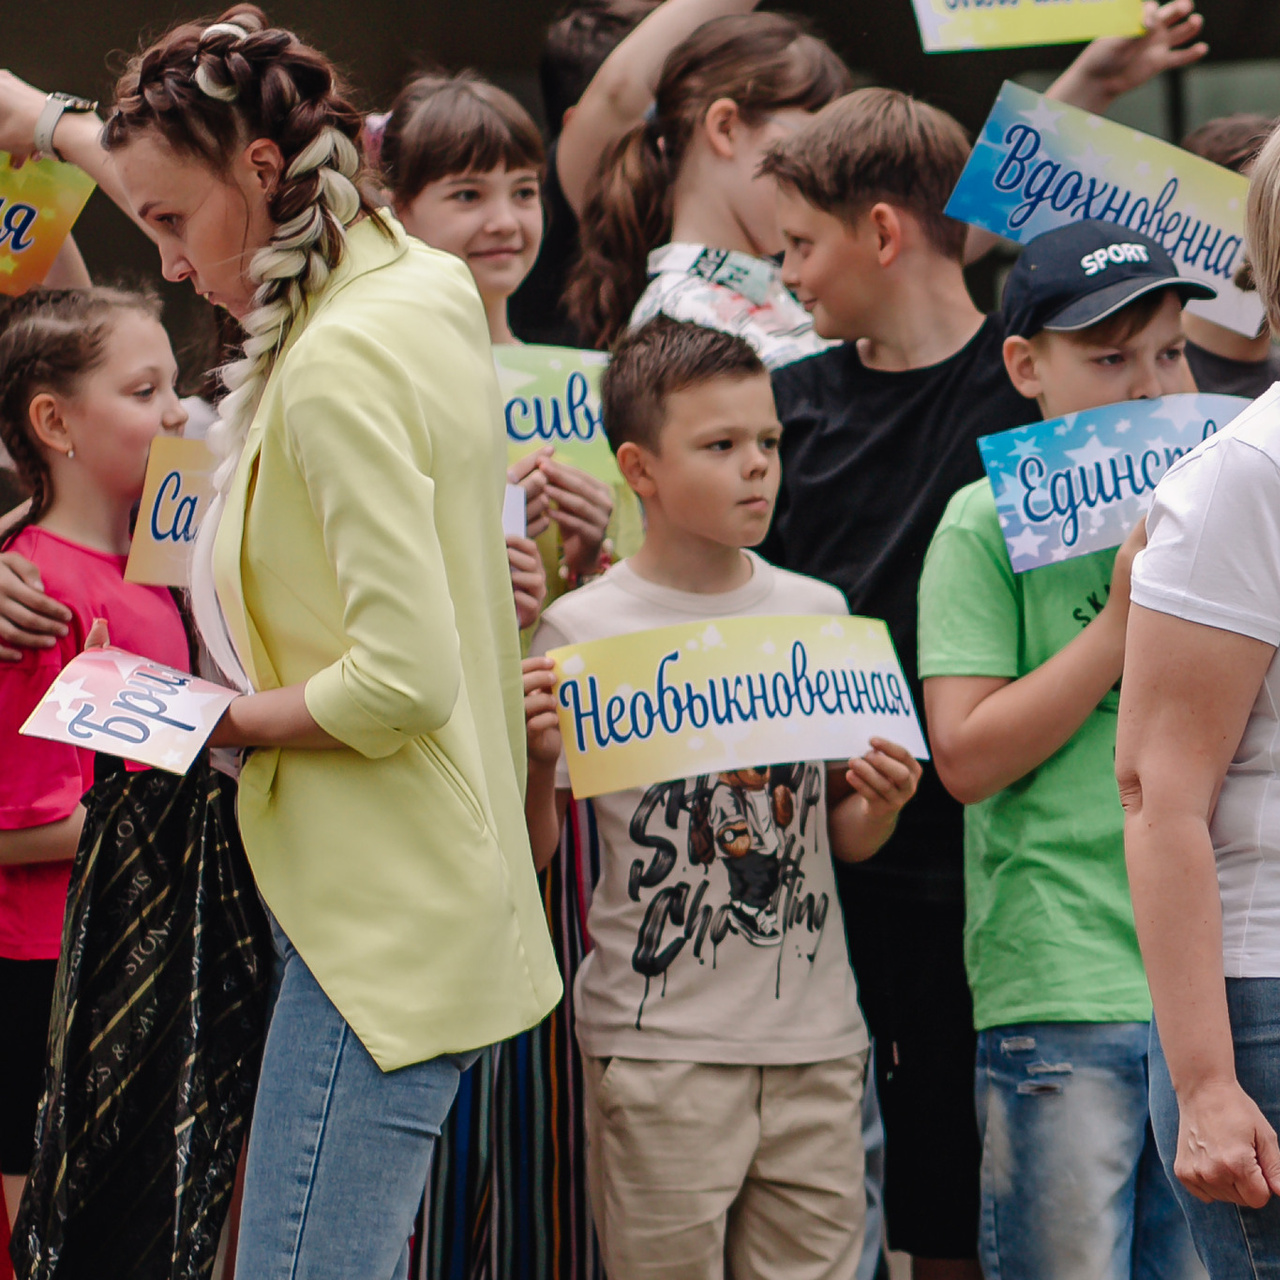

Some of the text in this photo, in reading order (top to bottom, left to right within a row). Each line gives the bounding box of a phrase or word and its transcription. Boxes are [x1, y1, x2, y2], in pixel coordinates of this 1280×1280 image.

[994, 123, 1244, 279] Вдохновенна
[1080, 243, 1150, 277] SPORT
[559, 640, 911, 752] Необыкновенная
